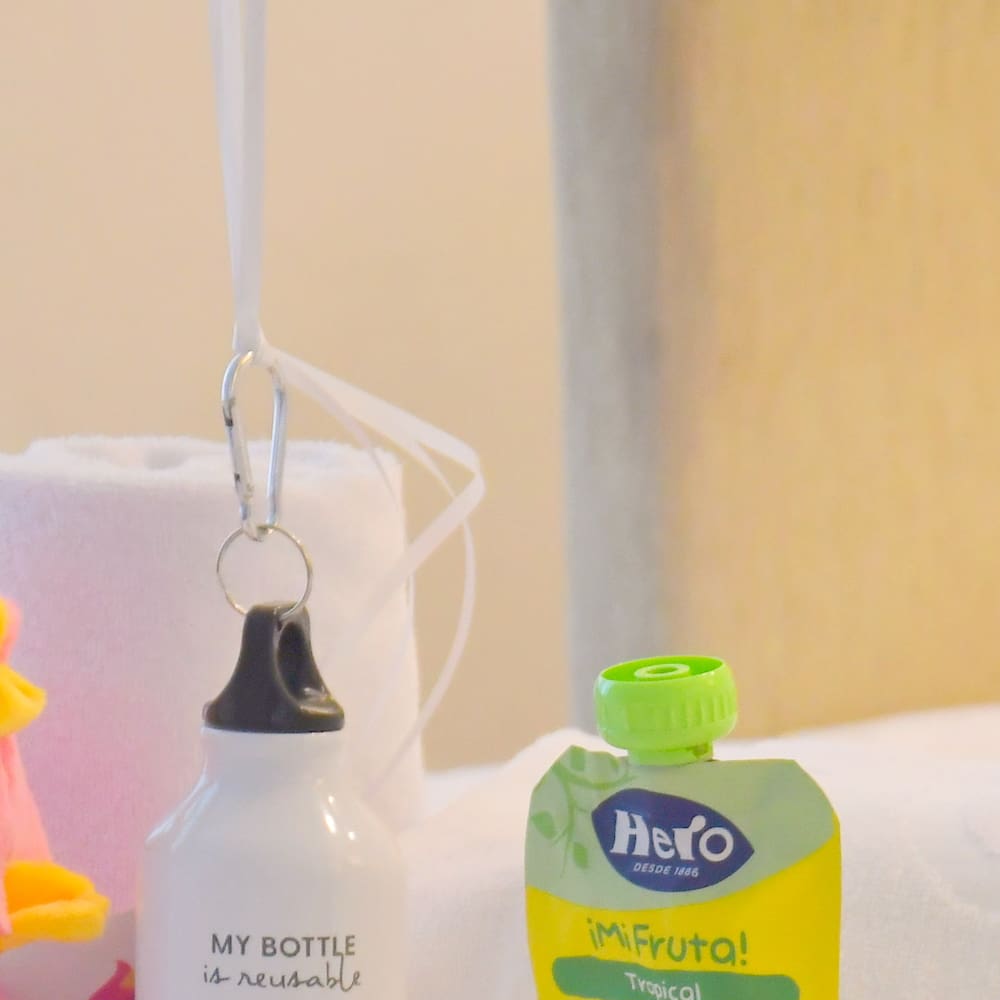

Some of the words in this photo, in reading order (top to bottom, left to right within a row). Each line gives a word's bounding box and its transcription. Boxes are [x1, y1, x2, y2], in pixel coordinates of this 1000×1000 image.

[609, 808, 734, 863] Hero
[633, 862, 671, 876] DESDE
[674, 865, 700, 878] 1886
[211, 934, 251, 956] MY
[261, 935, 356, 957] BOTTLE
[633, 923, 748, 967] Fruta!
[203, 964, 230, 985] is
[237, 955, 361, 992] reusable
